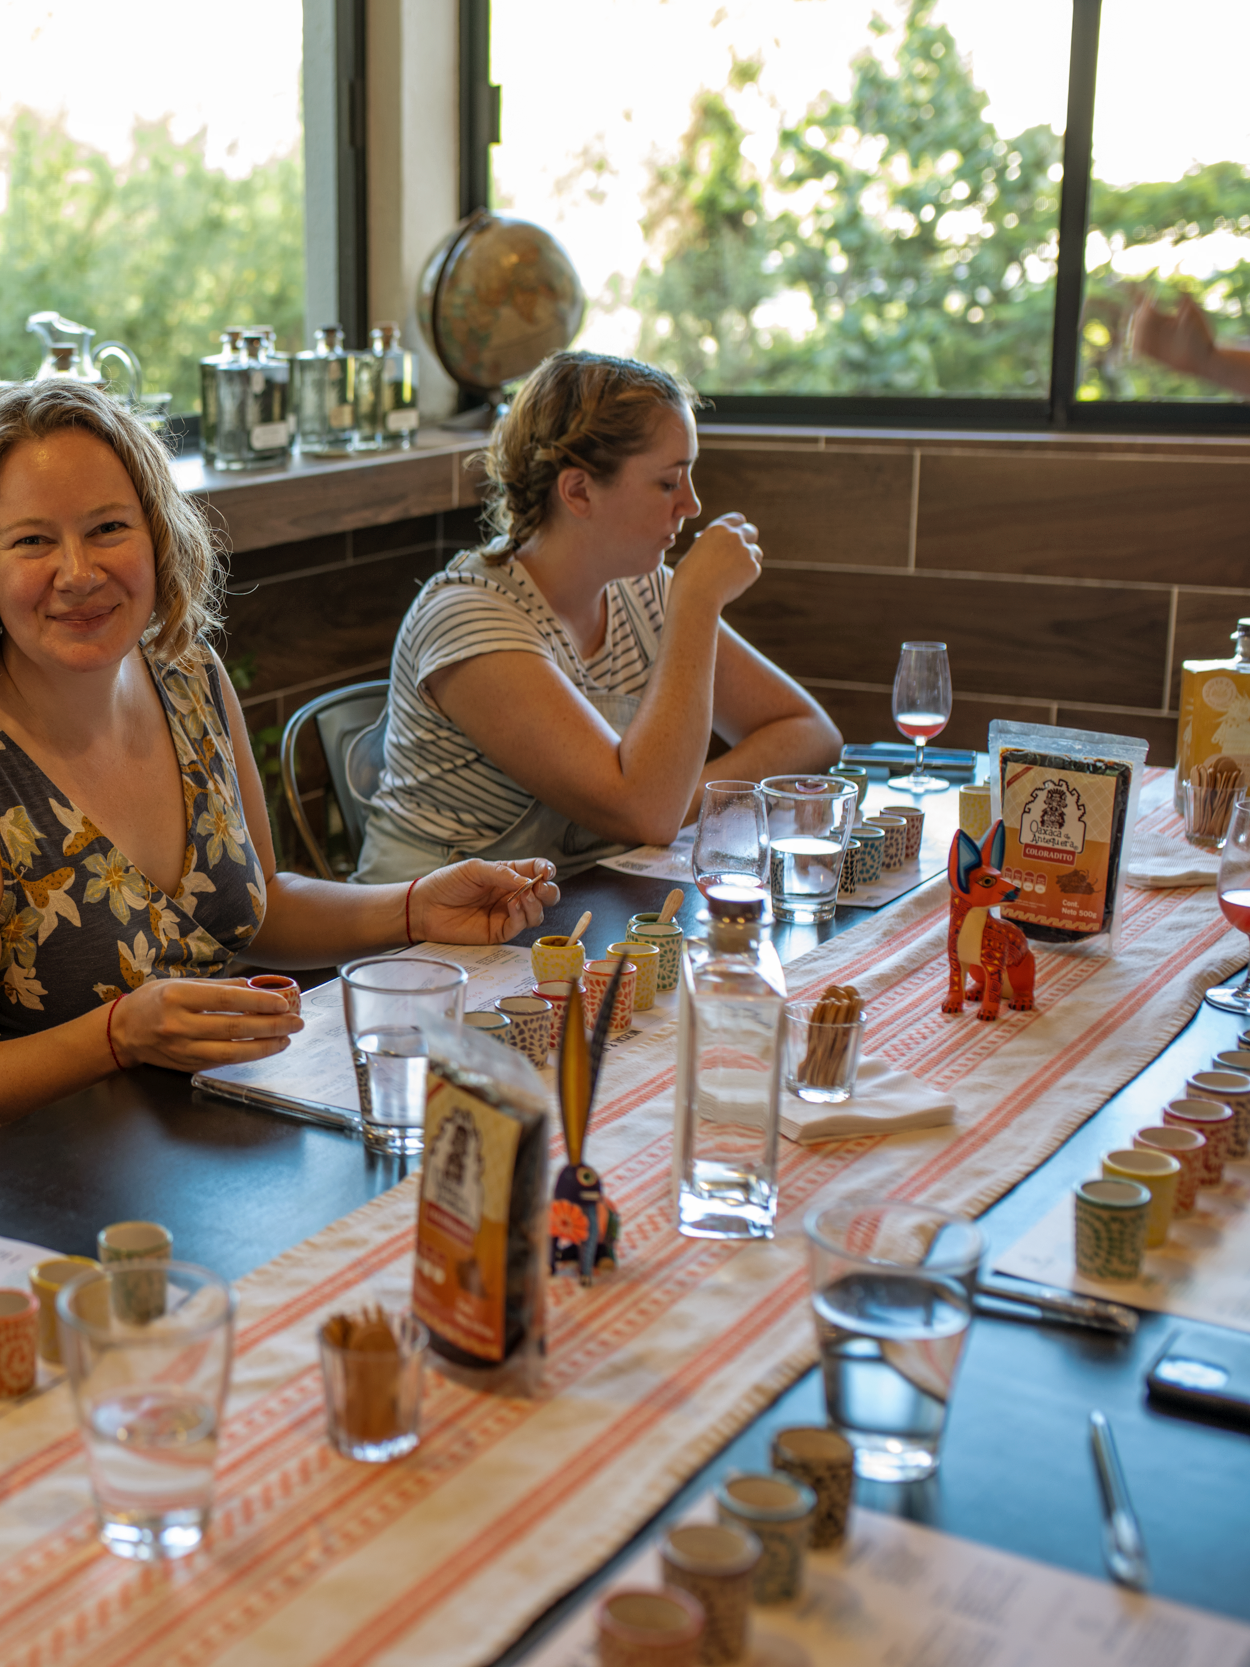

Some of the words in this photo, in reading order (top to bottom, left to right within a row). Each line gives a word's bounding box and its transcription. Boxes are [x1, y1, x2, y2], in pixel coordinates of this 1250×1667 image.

[1030, 820, 1062, 838] Oaxaca
[1031, 834, 1075, 848] Antequera
[1026, 847, 1073, 862] COLORADITO
[1062, 899, 1079, 908] Cont.
[1062, 907, 1077, 916] Neto
